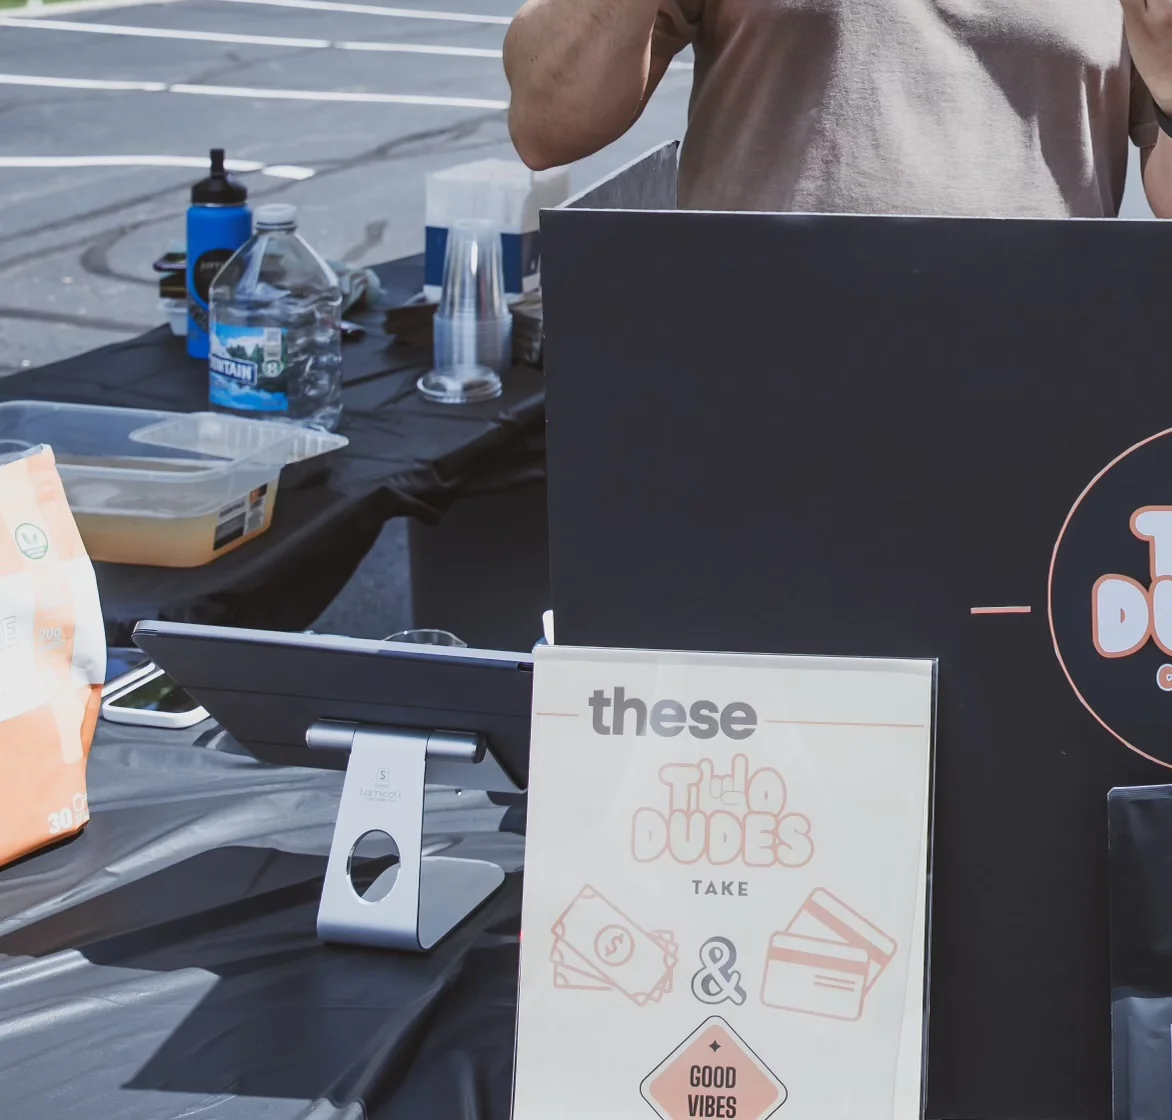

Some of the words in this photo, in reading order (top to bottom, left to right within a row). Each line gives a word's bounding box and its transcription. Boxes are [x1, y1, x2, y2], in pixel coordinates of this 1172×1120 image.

[588, 686, 758, 740] these
[47, 807, 73, 834] 30
[631, 807, 814, 868] DUDES
[692, 879, 749, 897] TAKE
[689, 1065, 737, 1090] GOOD
[687, 1094, 737, 1120] VIBES
